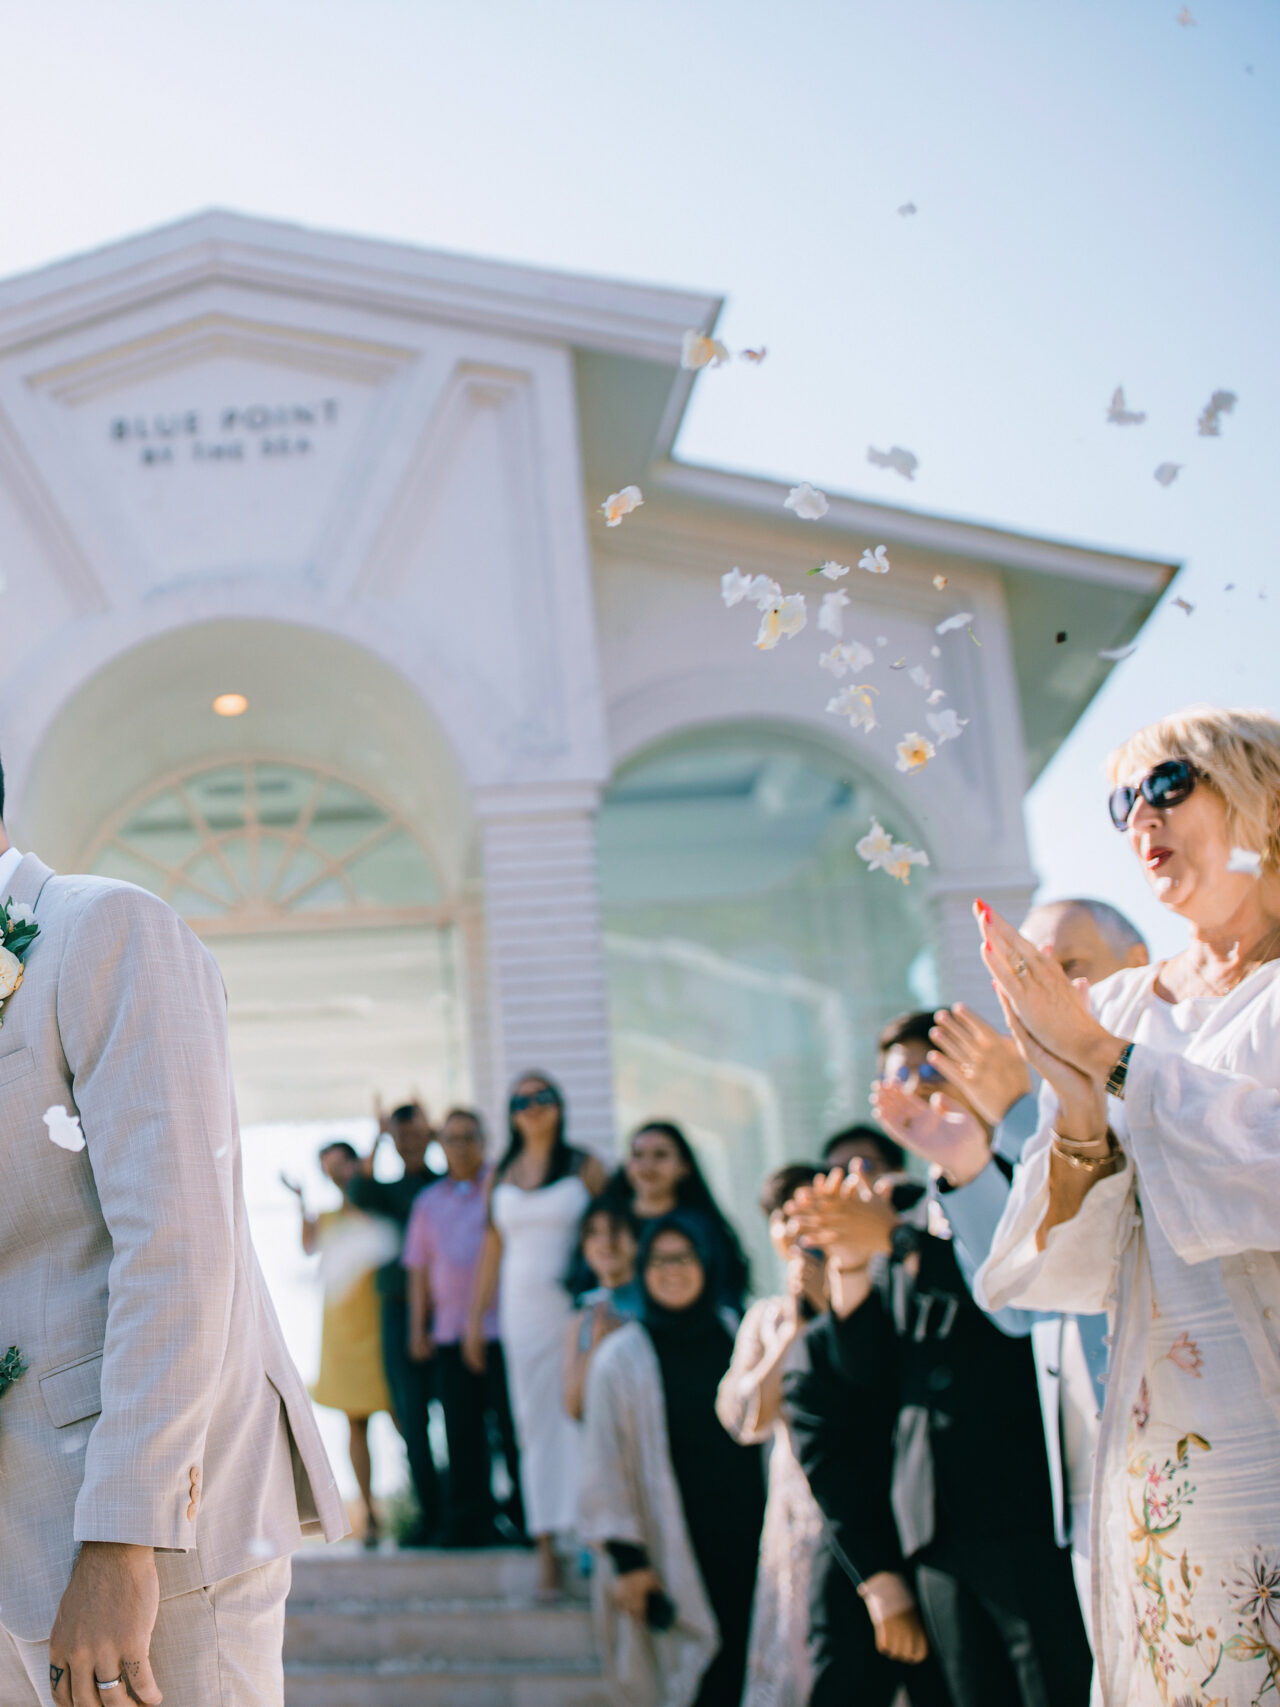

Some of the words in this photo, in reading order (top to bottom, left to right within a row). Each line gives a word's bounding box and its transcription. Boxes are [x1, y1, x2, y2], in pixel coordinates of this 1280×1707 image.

[111, 410, 199, 440] BLUE
[222, 398, 338, 430] POINT
[191, 440, 244, 461] THE
[261, 436, 312, 456] SEA
